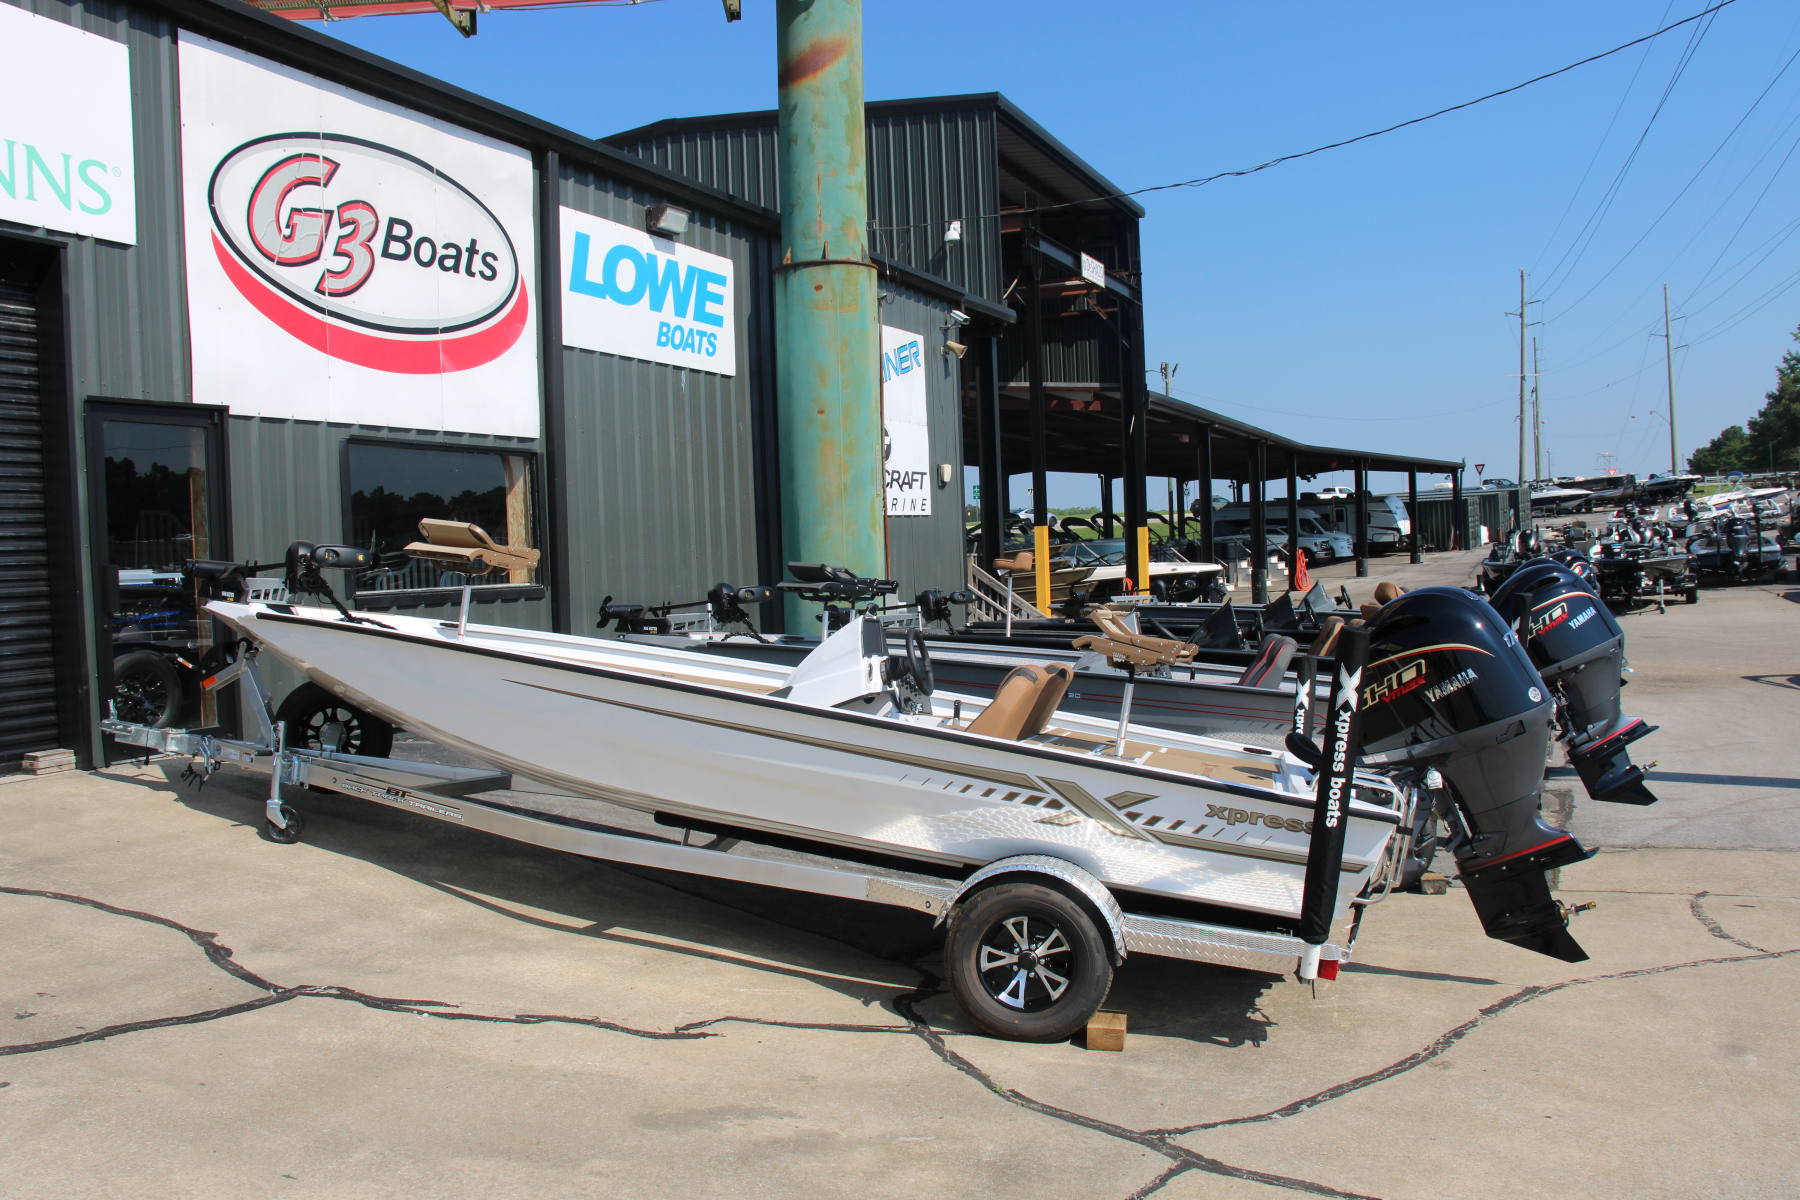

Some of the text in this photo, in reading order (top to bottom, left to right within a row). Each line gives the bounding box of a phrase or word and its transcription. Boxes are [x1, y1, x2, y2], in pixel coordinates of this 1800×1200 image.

[246, 152, 499, 298] G3 Boats
[569, 231, 728, 329] LOWE
[656, 320, 718, 357] BOATS
[882, 340, 922, 383] INER
[891, 497, 927, 511] RINE
[1568, 606, 1597, 630] YAMAHA
[1424, 667, 1480, 703] YAMAHA
[1331, 709, 1352, 773] xpress
[371, 790, 407, 804] TRACK
[408, 800, 463, 820] TRAILERS
[1325, 776, 1346, 828] boats
